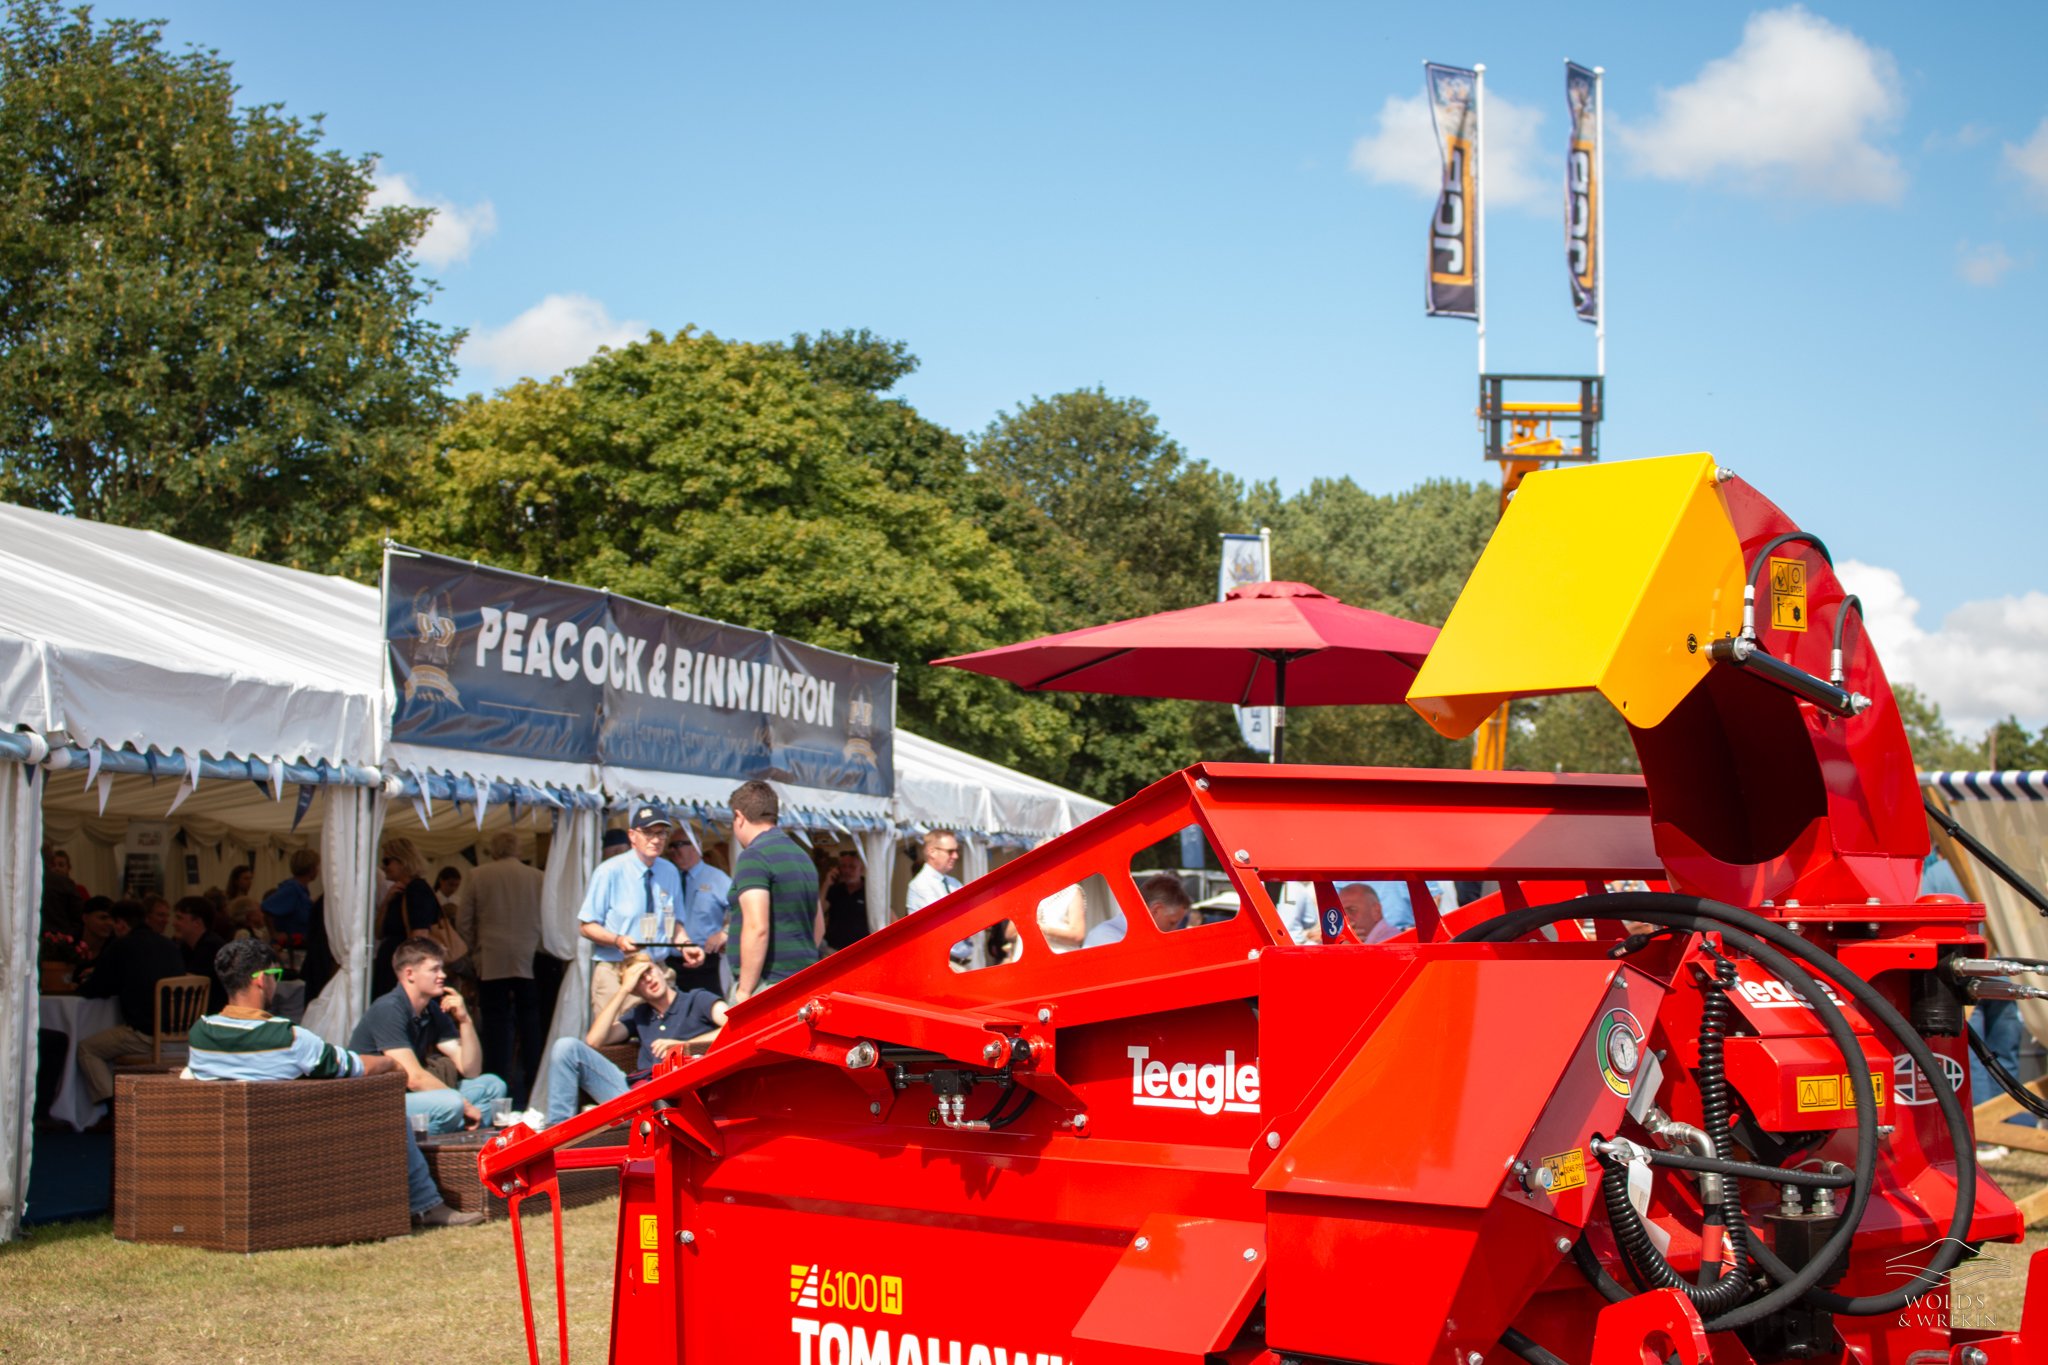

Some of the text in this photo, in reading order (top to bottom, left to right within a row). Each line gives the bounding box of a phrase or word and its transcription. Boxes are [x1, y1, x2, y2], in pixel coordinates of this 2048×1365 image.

[476, 606, 836, 728] PEACOCK & BINNINGTON
[1127, 1045, 1260, 1116] Teagle
